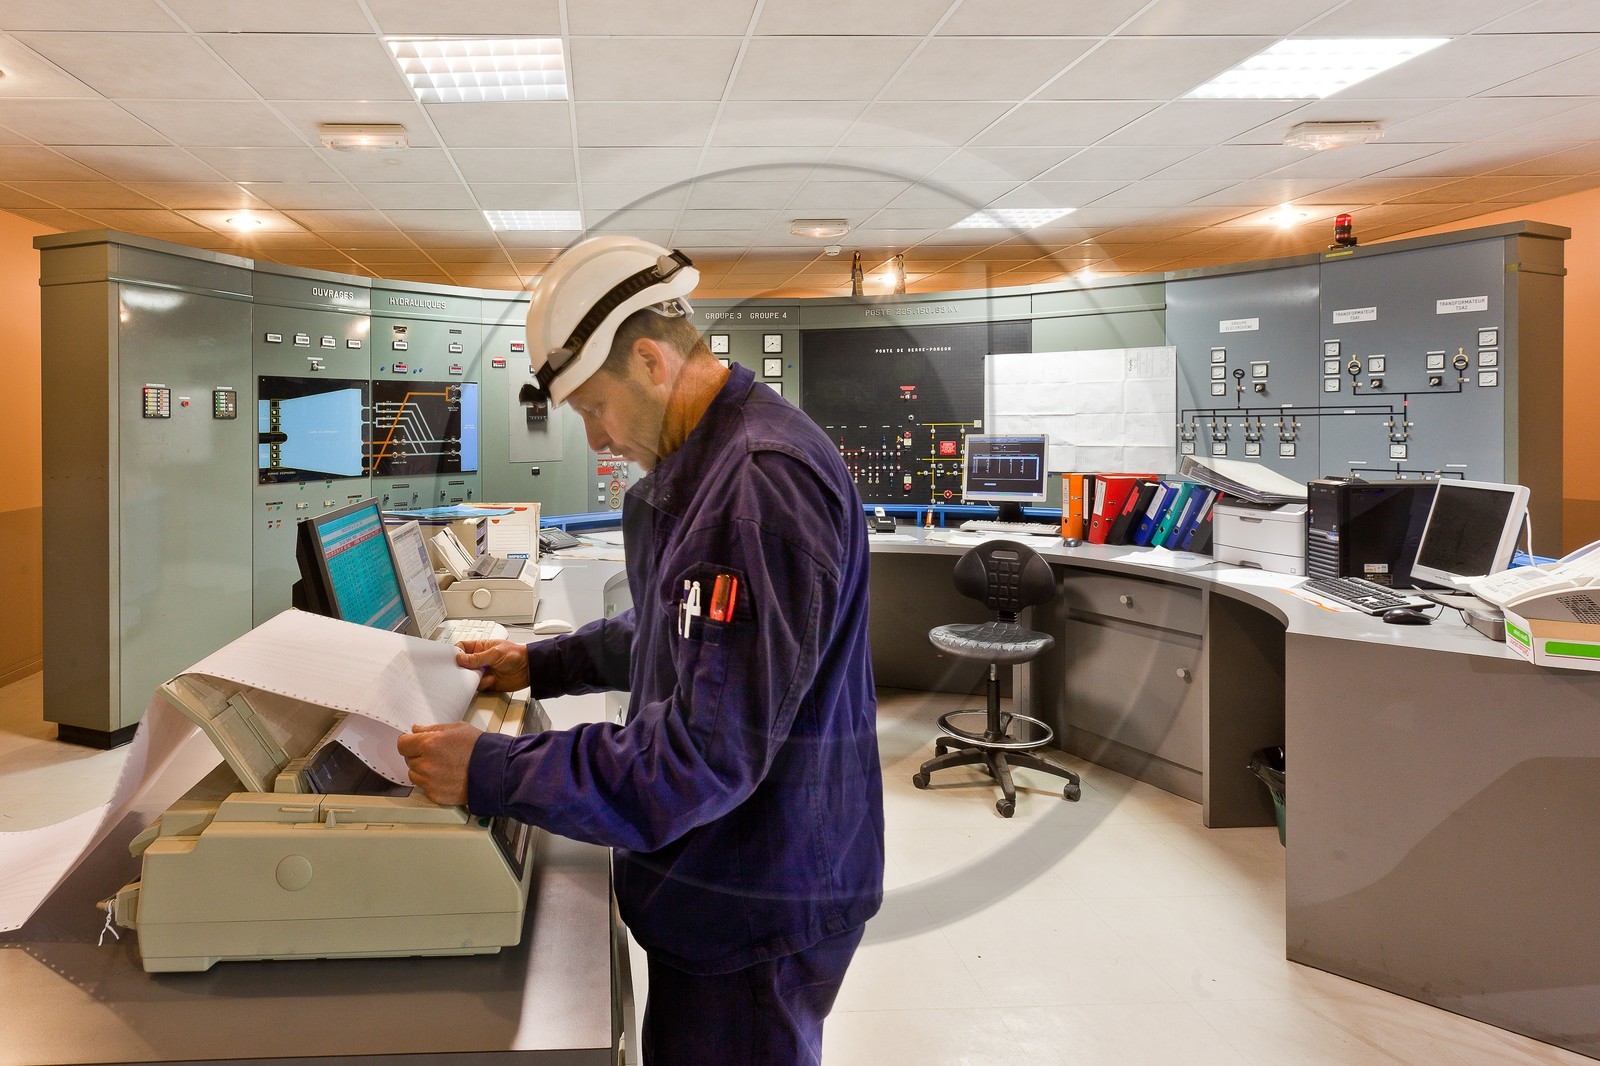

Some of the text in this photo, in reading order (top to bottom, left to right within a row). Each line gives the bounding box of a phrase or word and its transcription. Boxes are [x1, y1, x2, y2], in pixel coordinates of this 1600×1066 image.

[312, 287, 447, 309] OUVRAGES HYDRAULIQUES
[1439, 298, 1485, 306] TRANSFORMATEUR
[865, 308, 891, 316] POSTE
[947, 304, 960, 313] KV
[705, 312, 735, 320] GROUPE
